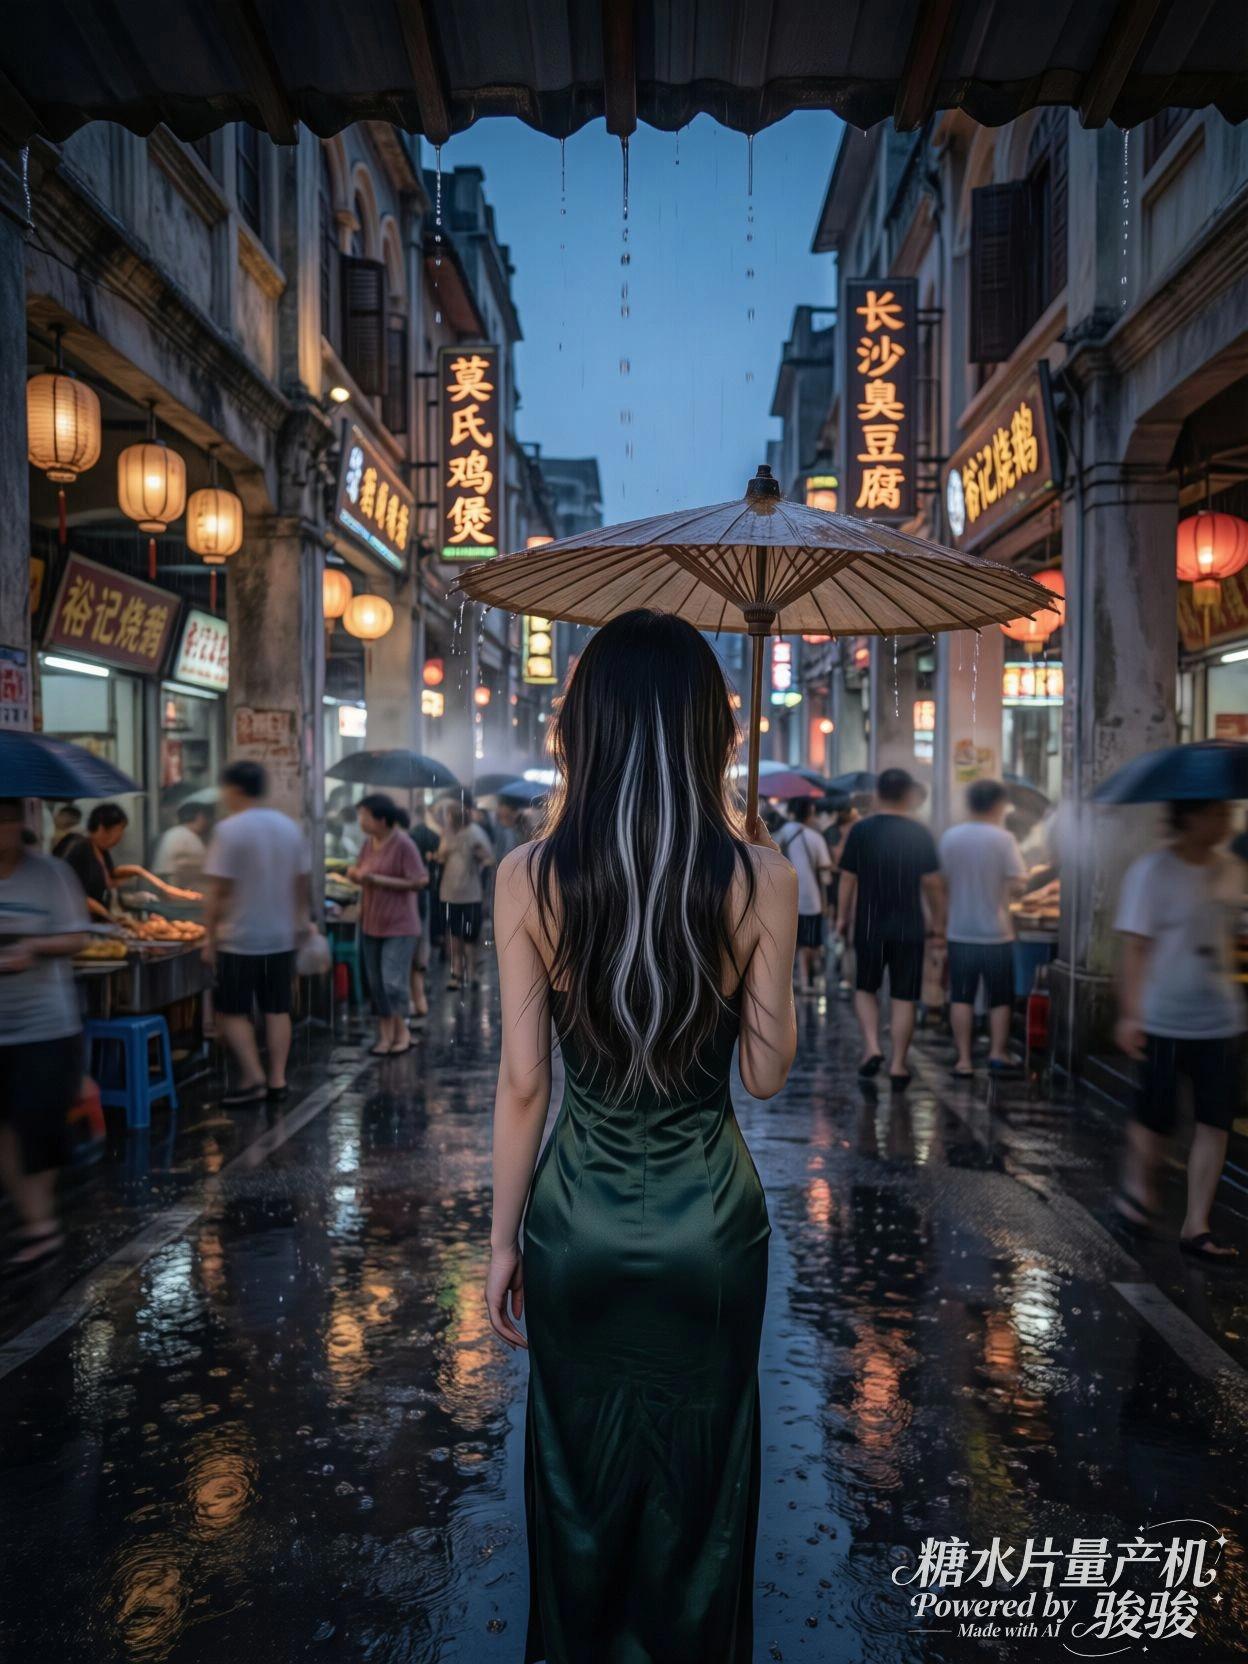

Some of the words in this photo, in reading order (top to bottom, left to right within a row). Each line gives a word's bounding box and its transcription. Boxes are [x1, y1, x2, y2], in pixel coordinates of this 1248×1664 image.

[446, 355, 496, 545] 莫氏鸡煲
[856, 290, 906, 510] 长沙臭豆腐
